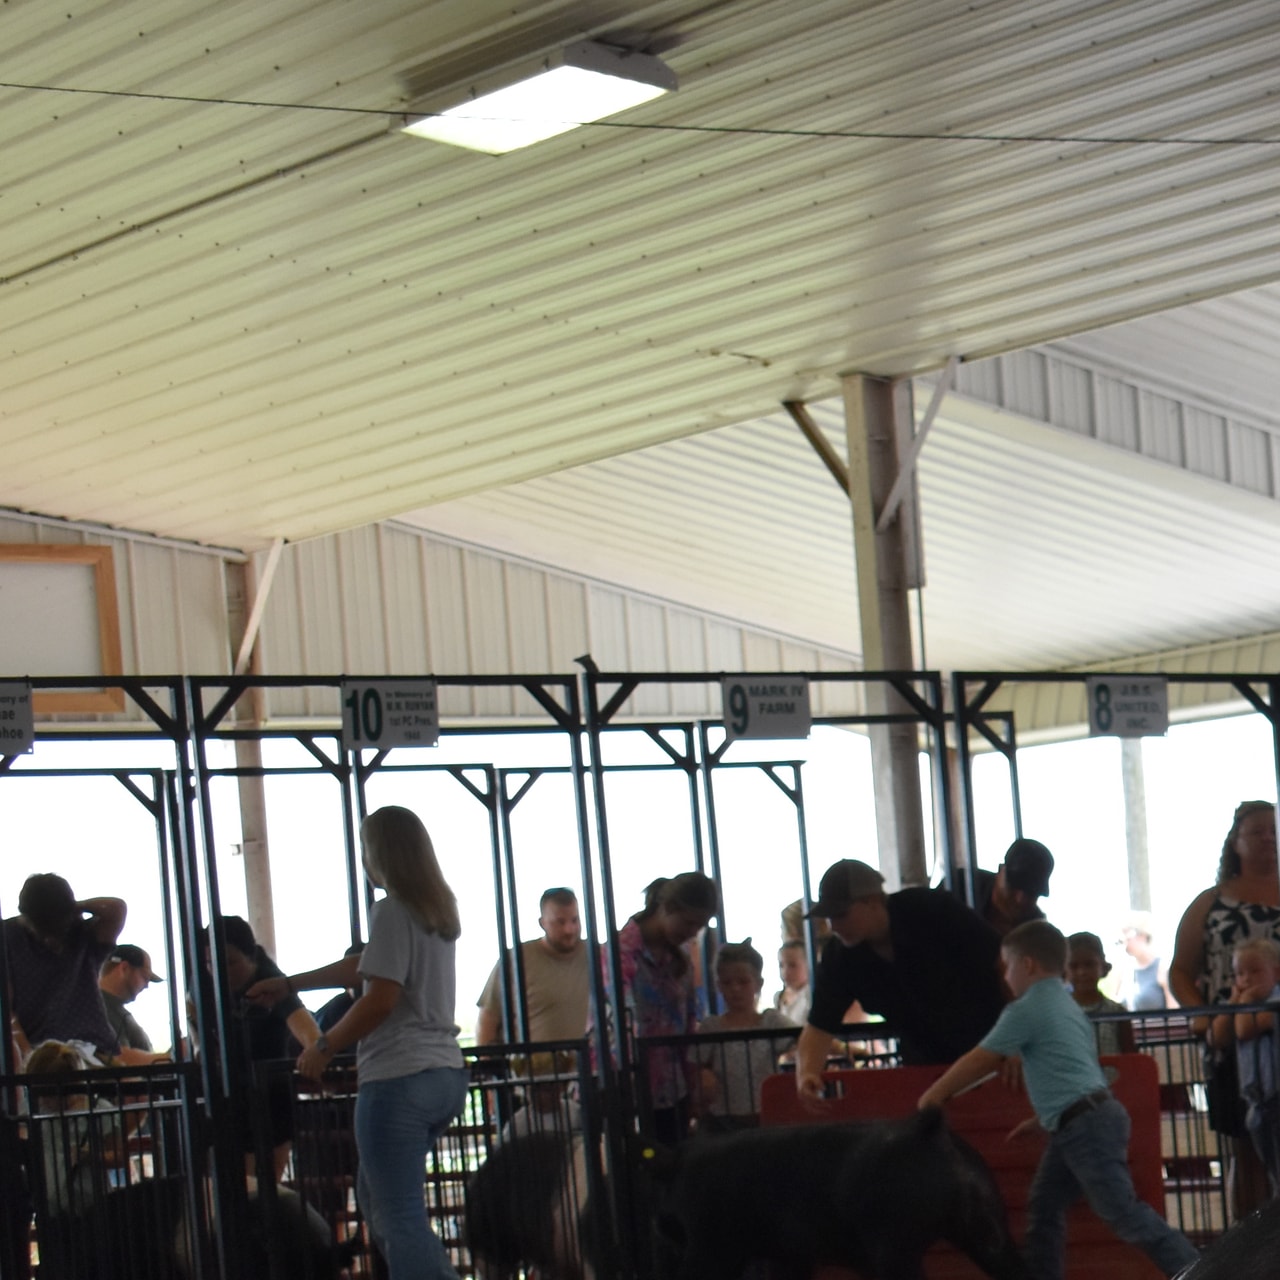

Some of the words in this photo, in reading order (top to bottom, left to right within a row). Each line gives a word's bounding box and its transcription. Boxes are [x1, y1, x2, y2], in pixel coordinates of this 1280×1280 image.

[345, 687, 384, 742] 10
[728, 684, 749, 736] 9
[748, 685, 788, 698] MARK
[758, 702, 797, 715] FARM
[1095, 683, 1112, 732] 8
